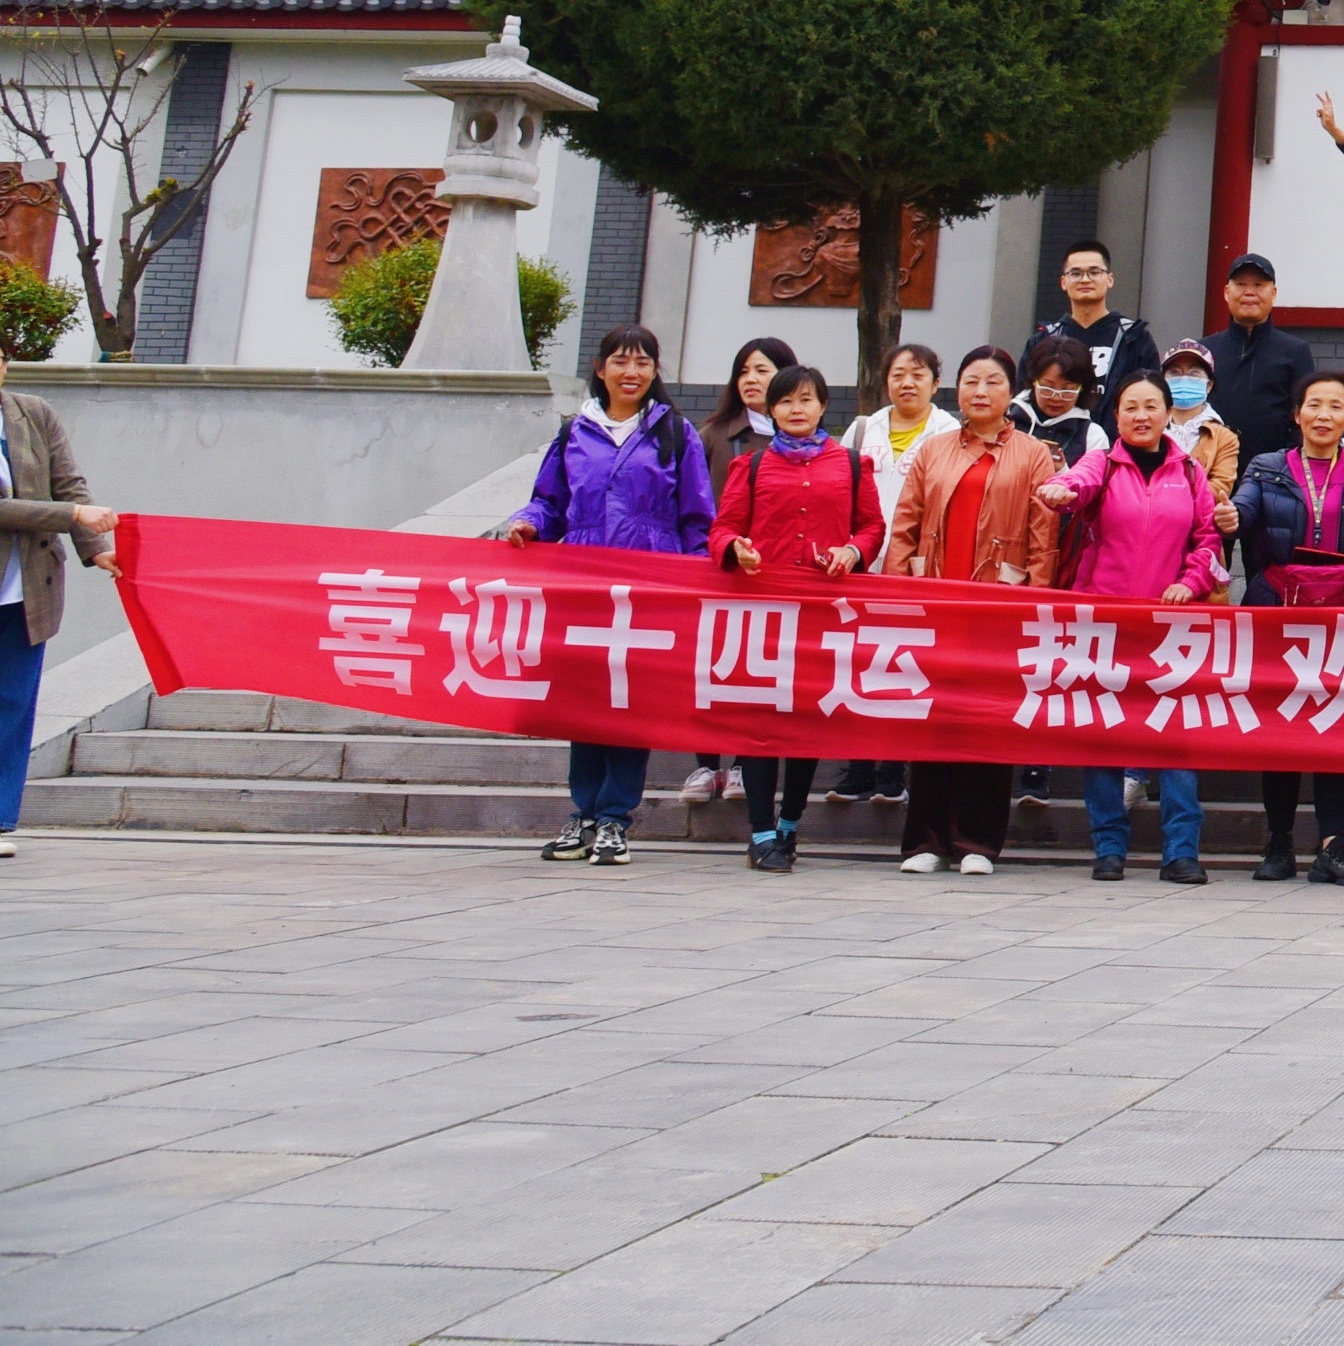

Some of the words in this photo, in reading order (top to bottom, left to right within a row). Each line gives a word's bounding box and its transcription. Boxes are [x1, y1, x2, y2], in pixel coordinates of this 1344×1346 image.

[317, 568, 937, 721] 喜迎十四运
